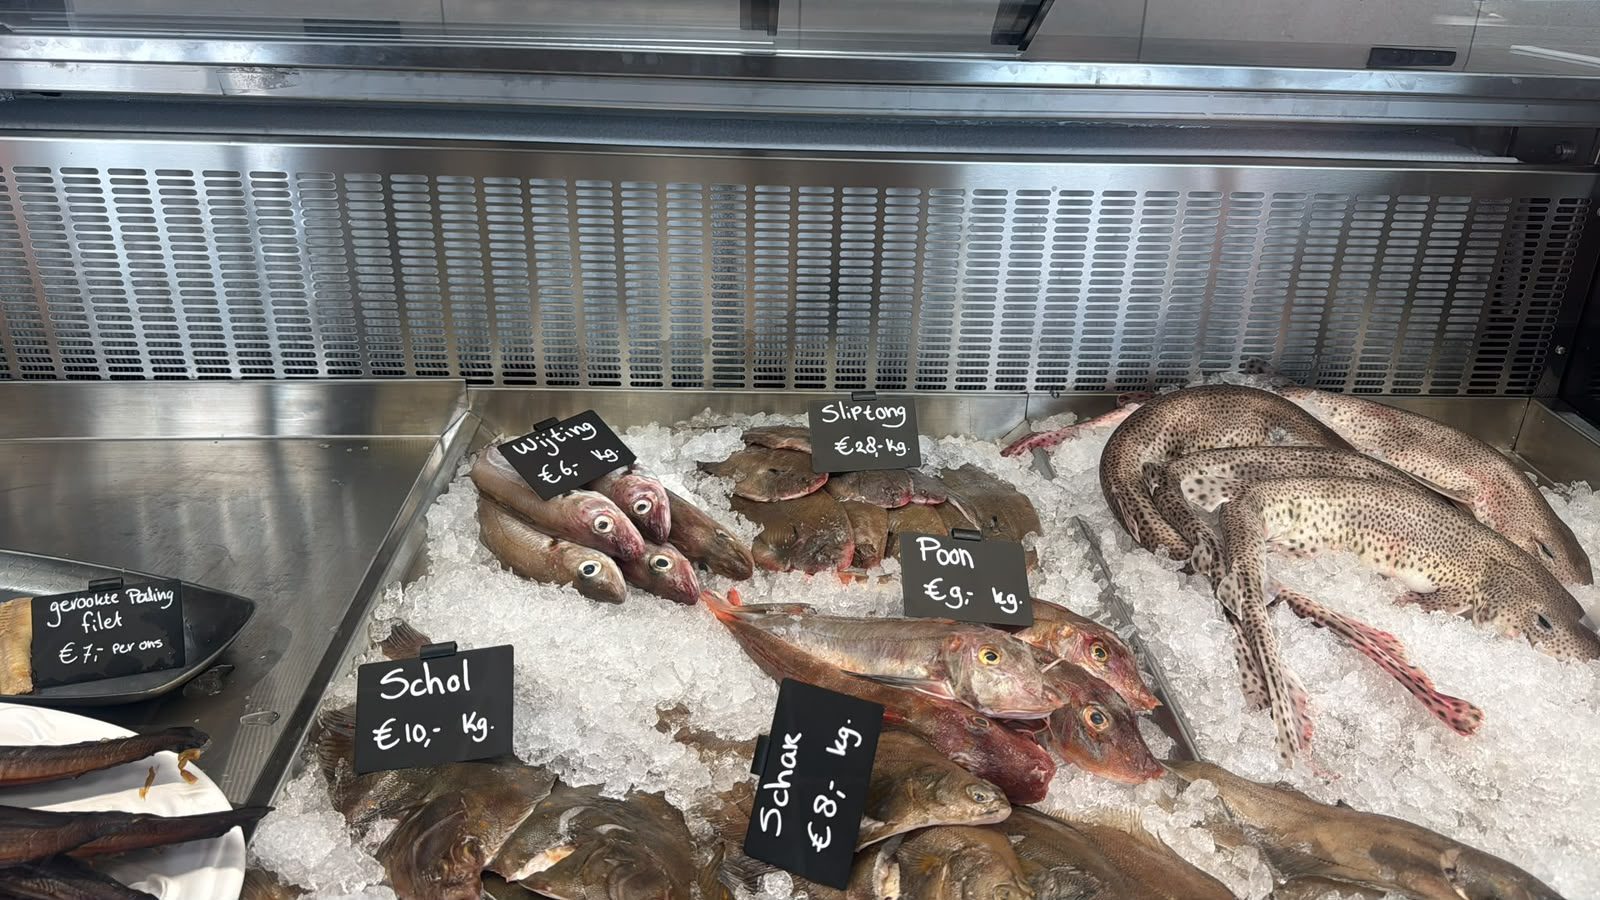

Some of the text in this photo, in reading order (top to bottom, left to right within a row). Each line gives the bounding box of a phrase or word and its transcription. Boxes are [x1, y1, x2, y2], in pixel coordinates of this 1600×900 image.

[821, 400, 907, 428] Sliptong
[511, 422, 597, 456] Wijting
[915, 536, 975, 569] Poon
[46, 586, 174, 628] gerookte Paling
[81, 610, 123, 634] filet
[138, 638, 163, 650] ons
[379, 658, 471, 700] Schol
